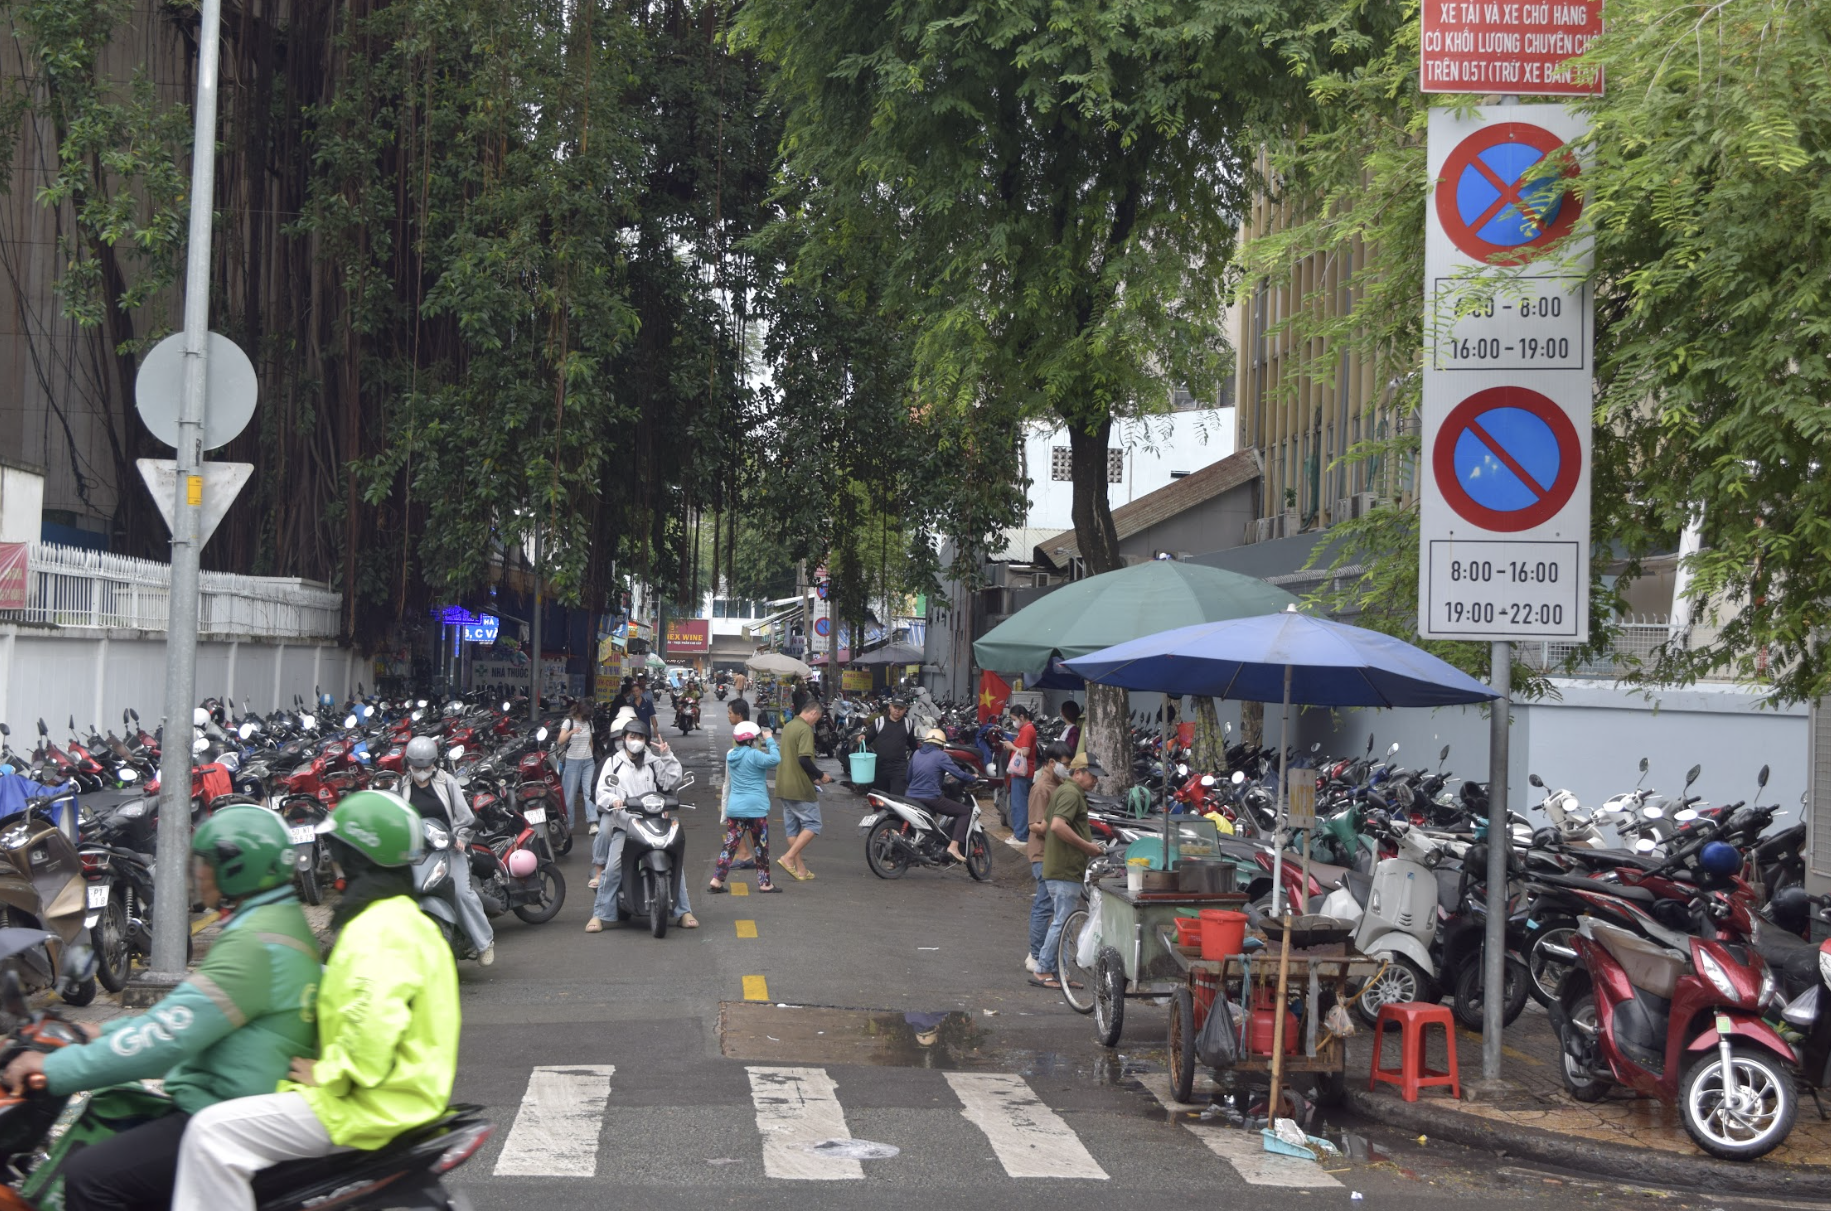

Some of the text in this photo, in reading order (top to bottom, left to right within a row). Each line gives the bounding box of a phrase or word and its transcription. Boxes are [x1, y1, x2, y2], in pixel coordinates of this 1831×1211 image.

[1440, 0, 1586, 26] XE TẢI VÀ XE CHỞ HÀNG
[1426, 30, 1440, 52] CÓ
[1445, 27, 1474, 52] KHỐI
[1478, 32, 1520, 56] LƯỢNG
[1524, 31, 1572, 54] CHUYÊN
[1426, 58, 1458, 81] TRÊN
[1488, 59, 1520, 82] (TRỪ
[1523, 62, 1540, 82] XE
[508, 664, 528, 678] THUỐC
